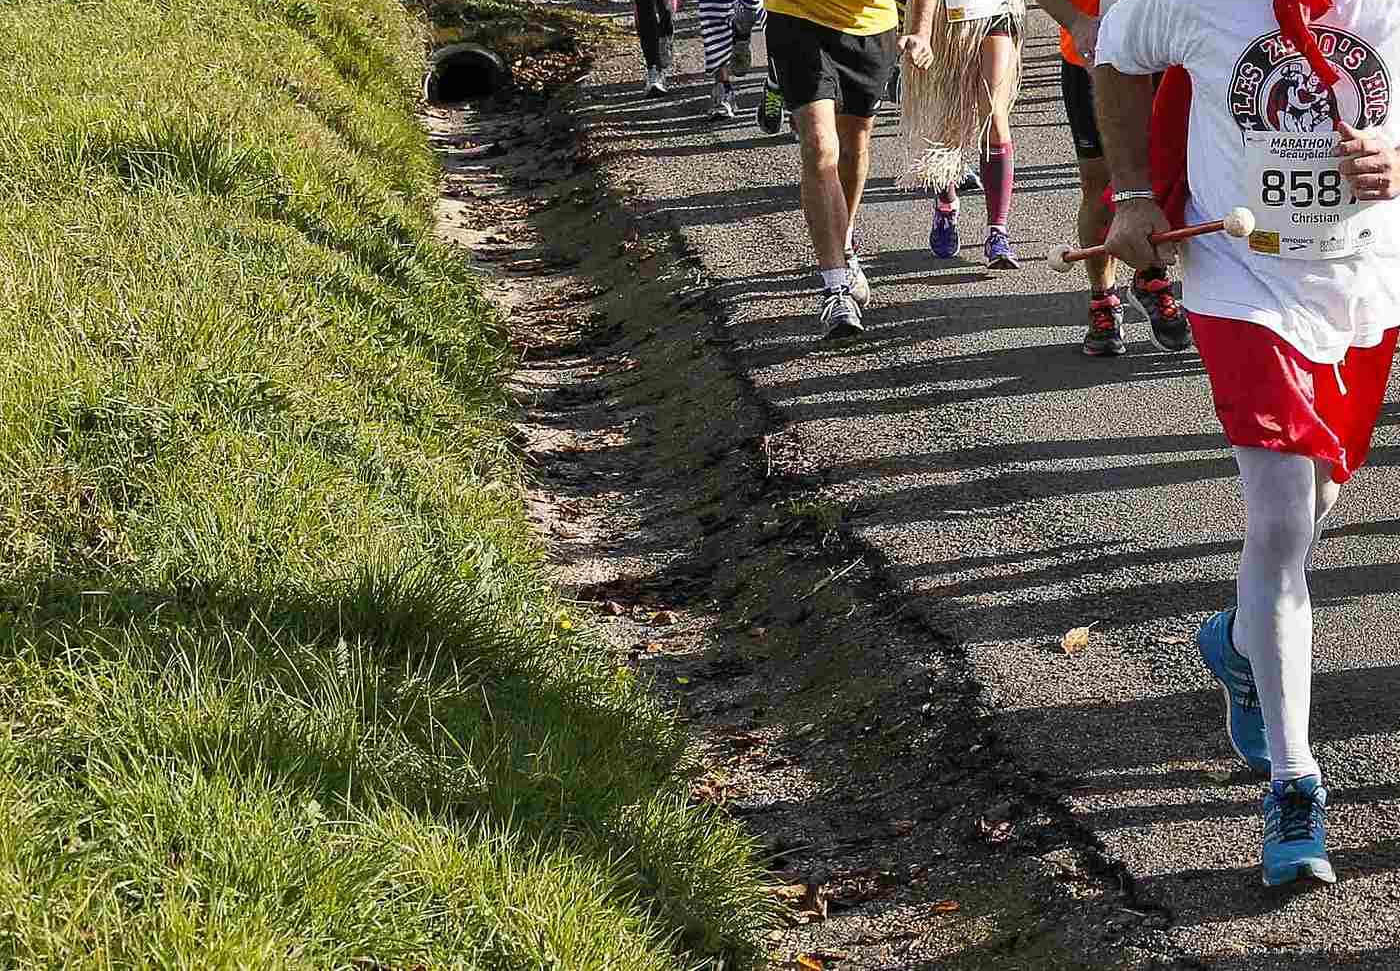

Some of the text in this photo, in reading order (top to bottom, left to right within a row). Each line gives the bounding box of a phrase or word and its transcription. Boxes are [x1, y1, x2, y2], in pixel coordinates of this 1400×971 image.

[1232, 62, 1264, 116] LES
[1271, 137, 1333, 149] MARATHON
[1279, 148, 1329, 161] Beaujolai
[1262, 169, 1360, 209] 858
[1291, 211, 1341, 225] Christian
